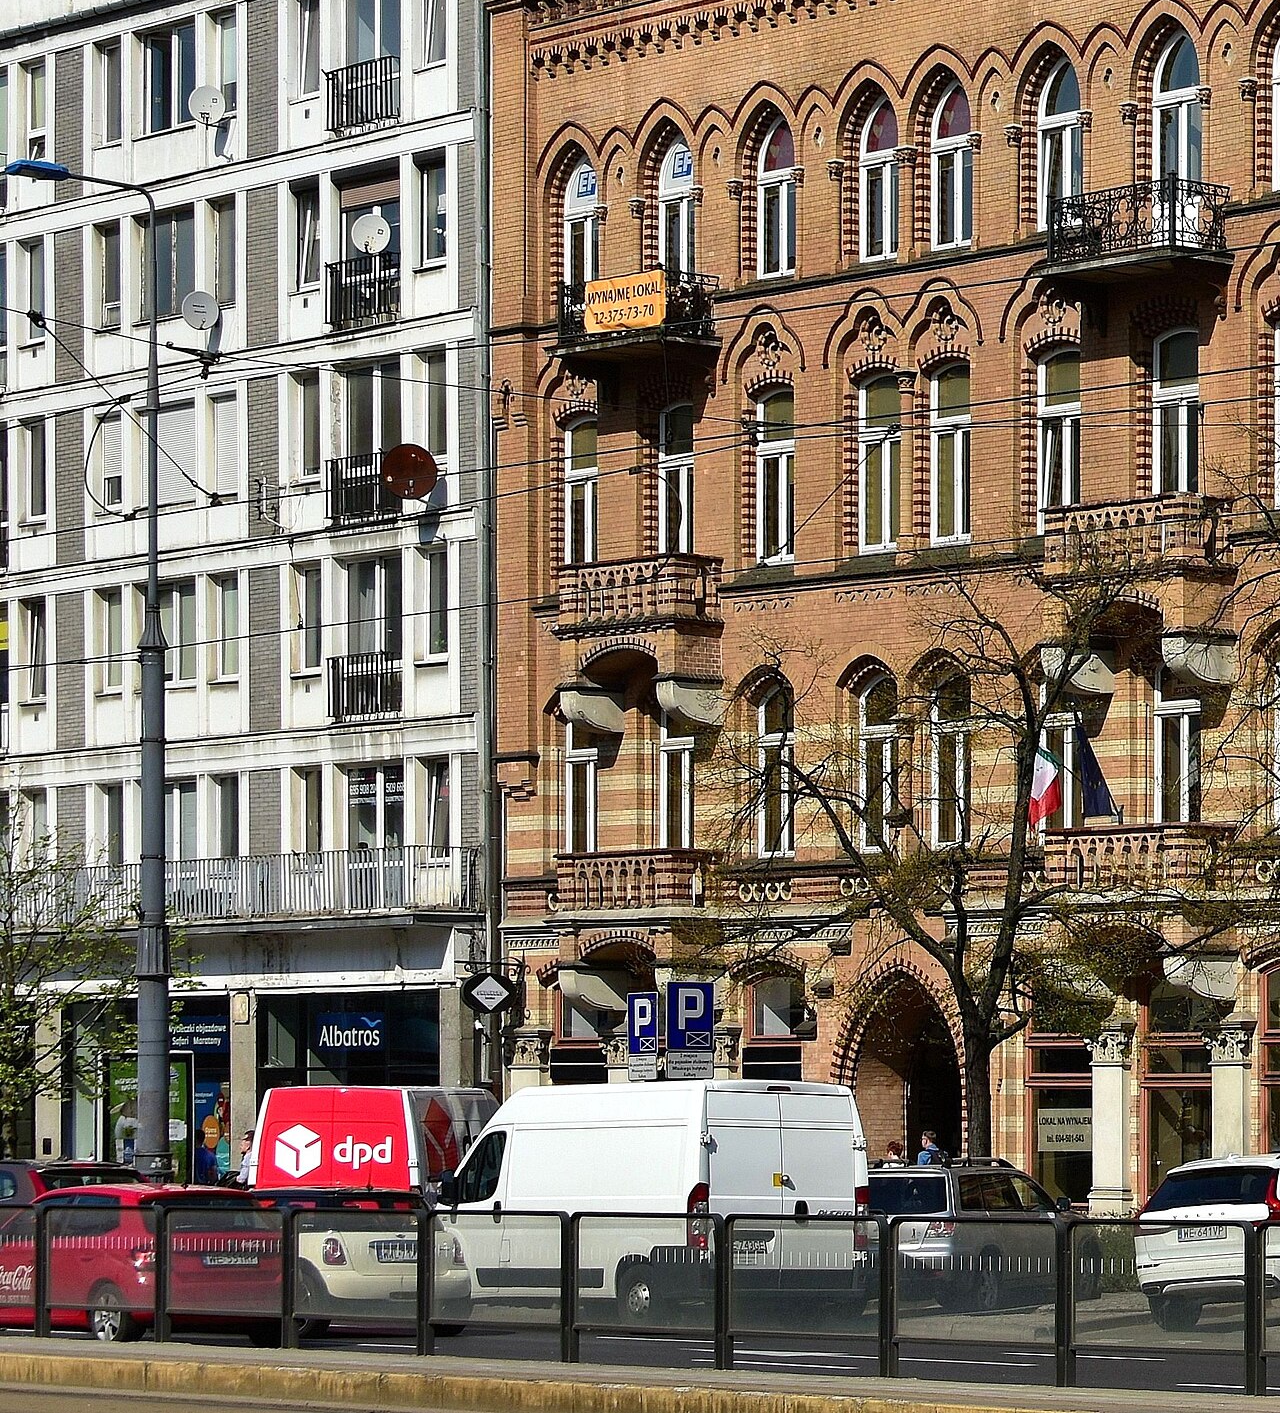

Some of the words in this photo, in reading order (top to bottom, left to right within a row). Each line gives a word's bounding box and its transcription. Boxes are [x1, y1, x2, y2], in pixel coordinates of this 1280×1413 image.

[588, 286, 630, 305] WYNAJMĘ
[632, 280, 661, 297] LOKAL
[634, 998, 651, 1036] P
[678, 988, 704, 1029] P
[319, 1025, 380, 1046] Albatros
[1039, 1117, 1057, 1125] LOKAL
[1058, 1117, 1066, 1125] NA
[333, 1135, 393, 1170] dpd
[1173, 1212, 1225, 1220] VOLVO
[1197, 1226, 1224, 1237] 641VP
